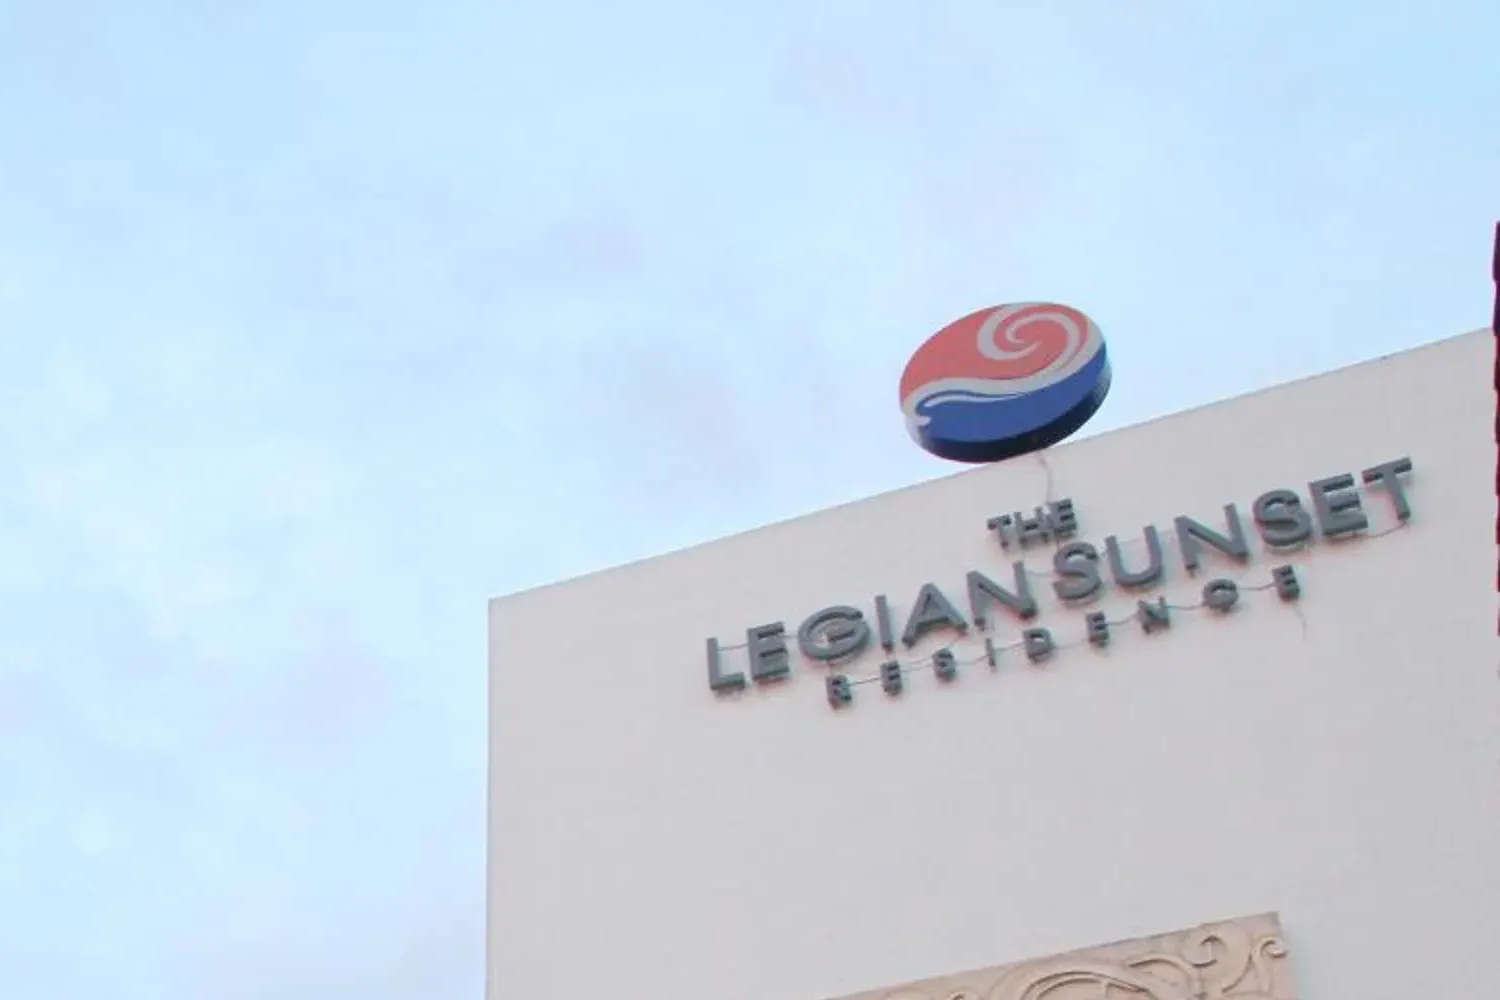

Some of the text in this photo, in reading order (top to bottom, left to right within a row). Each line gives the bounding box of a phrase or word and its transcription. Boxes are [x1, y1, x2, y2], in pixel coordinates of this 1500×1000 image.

[706, 457, 1412, 691] LEGIAN SUNSET
[987, 498, 1077, 549] THE
